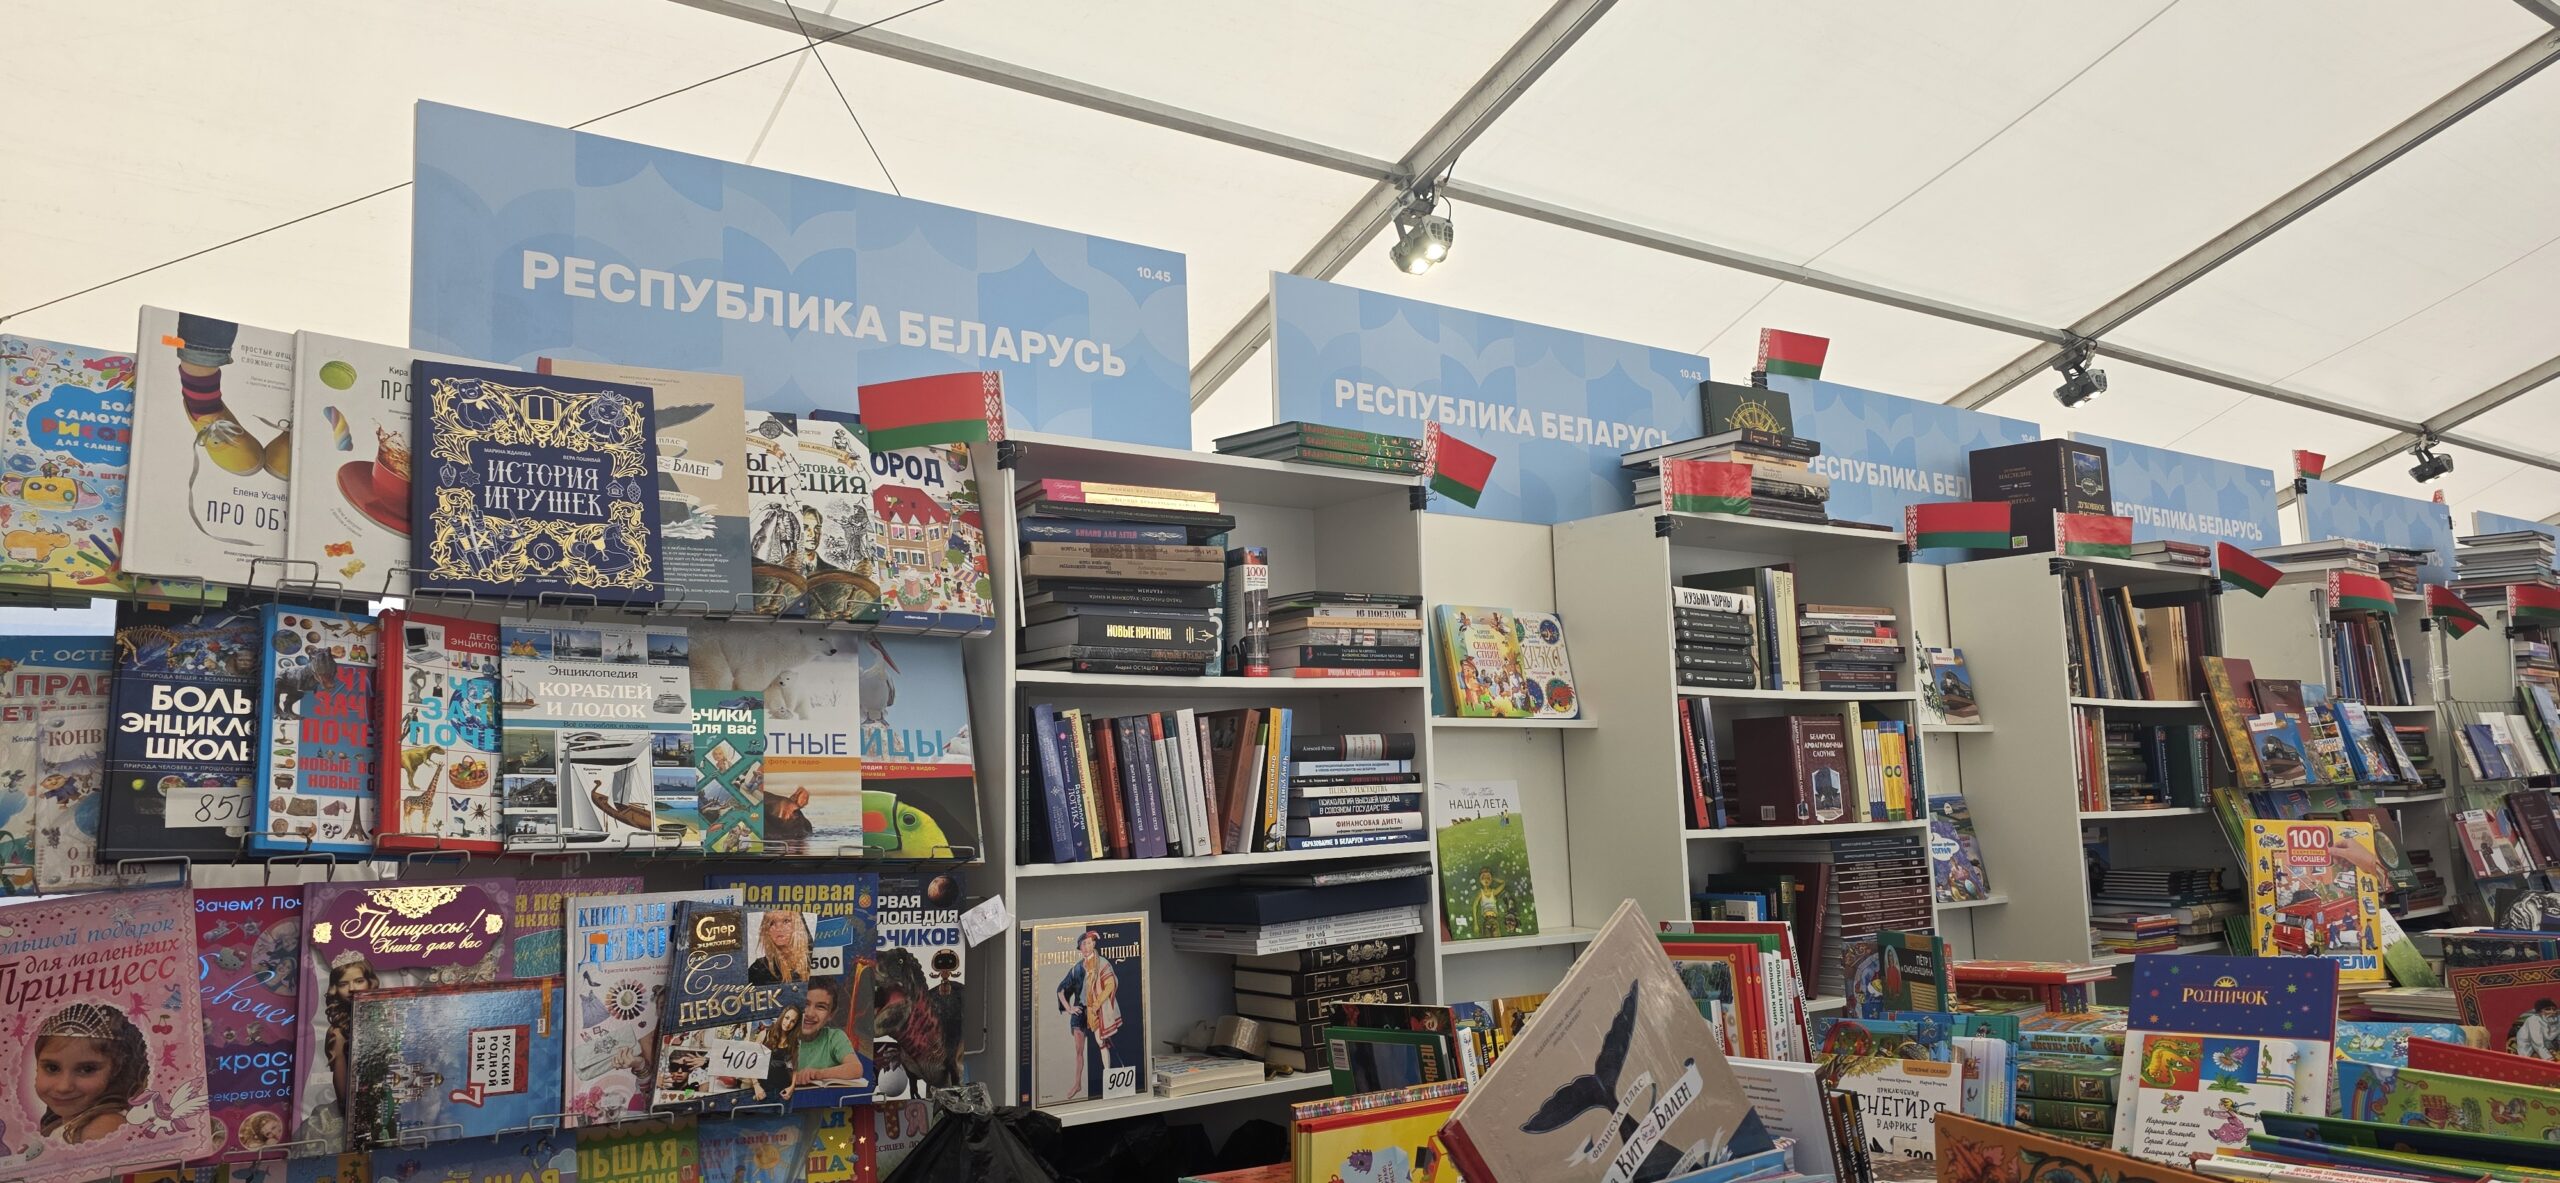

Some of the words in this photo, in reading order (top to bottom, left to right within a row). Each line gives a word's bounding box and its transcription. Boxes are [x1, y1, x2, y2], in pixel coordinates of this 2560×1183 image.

[1136, 266, 1172, 283] 10.45
[523, 250, 887, 342] РЕСПУБЛИКА
[899, 310, 1126, 377] БЕЛАРУСЬ
[389, 366, 409, 377] Кира
[1335, 379, 1531, 438] РЕСПУБЛИКА
[1541, 412, 1674, 451] БЕЛАРУСЬ
[55, 438, 79, 447] ДЛЯ
[84, 442, 122, 452] САМЫХ
[484, 447, 507, 456] МАРИНА
[487, 459, 599, 491] ИСТОРИЯ
[673, 458, 709, 477] БАЛЕН
[870, 452, 944, 488] ОРОД
[233, 487, 259, 499] Елена
[484, 485, 604, 517] ИГРУШЕК
[207, 501, 244, 525] ПРО
[2200, 515, 2262, 541] БЕЛАРУСЬ
[1246, 567, 1267, 577] 1000
[1683, 592, 1711, 606] КУЗЬМА
[1711, 595, 1733, 608] ЧОРНЫ
[1368, 609, 1407, 619] ПОЕЗДОК
[1107, 624, 1136, 639] НОВЫЕ
[1135, 625, 1172, 640] КРИТИКИ
[141, 672, 173, 680] ПРИРОДА
[548, 665, 638, 679] Энциклопедия
[151, 684, 253, 715] БОЛЬ
[539, 682, 653, 700] КОРАБЛЕЙ
[547, 703, 562, 716] И
[569, 703, 646, 719] ЛОДОК
[726, 723, 757, 736] вас
[861, 727, 944, 758] ИЦЫ
[299, 756, 352, 773] НОВЫЕ
[308, 773, 361, 791] НОВЫЕ
[1068, 787, 1080, 828] ЛОГИКА
[1318, 796, 1353, 806] ПСИХОЛОГИЯ
[1354, 796, 1378, 805] ВЫСШЕЙ
[1379, 795, 1400, 803] ШКОЛЫ
[1324, 806, 1352, 815] СОЮЗНОМ
[1352, 804, 1390, 813] ГОСУДАРСТВЕ
[1449, 798, 1481, 811] НАША
[1482, 798, 1509, 811] ЛЕТА
[1335, 820, 1379, 828] ФИНАНСОВАЯ
[2289, 829, 2326, 849] 100
[2291, 854, 2326, 864] ОКОШЕК
[771, 883, 855, 903] первая
[195, 897, 264, 912] Зачем?
[577, 905, 629, 928] КНИГА
[633, 903, 667, 924] ДЛЯ
[87, 917, 175, 943] подарок
[340, 908, 486, 948] Принцессы!
[696, 916, 736, 942] Супер
[25, 954, 62, 974] для
[68, 938, 180, 969] маленьких
[371, 937, 425, 955] Книга
[425, 938, 455, 958] для
[458, 933, 483, 950] вас
[810, 956, 840, 970] 500
[0, 956, 177, 1012] Принцесс
[684, 950, 755, 999] Супер
[1767, 961, 1776, 1001] БОЛЬШАЯ
[1775, 959, 1783, 996] БОЛЬШАЯ
[1790, 945, 1803, 988] БОЛЬШАЯ
[1799, 989, 1808, 1016] КНИГА
[678, 988, 783, 1026] ДЕВОЧЕК
[2182, 985, 2269, 1007] РОДНИЧОК
[475, 1036, 486, 1072] ЯЗЫК
[487, 1035, 499, 1088] РОДНОЙ
[501, 1034, 512, 1087] РУССКИЙ
[722, 1046, 758, 1069] 400
[1108, 1069, 1135, 1090] 900
[452, 1086, 482, 1105] 7
[1591, 1111, 1624, 1159] ФРАНСУА
[1623, 1078, 1645, 1107] ПЛАС
[1857, 1094, 1947, 1124] СНЕГИРЯ
[1614, 1137, 1646, 1177] КИТ
[1652, 1082, 1693, 1131] БАЛЕН
[1876, 1118, 1882, 1129] В
[1883, 1120, 1918, 1133] АФРИКЕ
